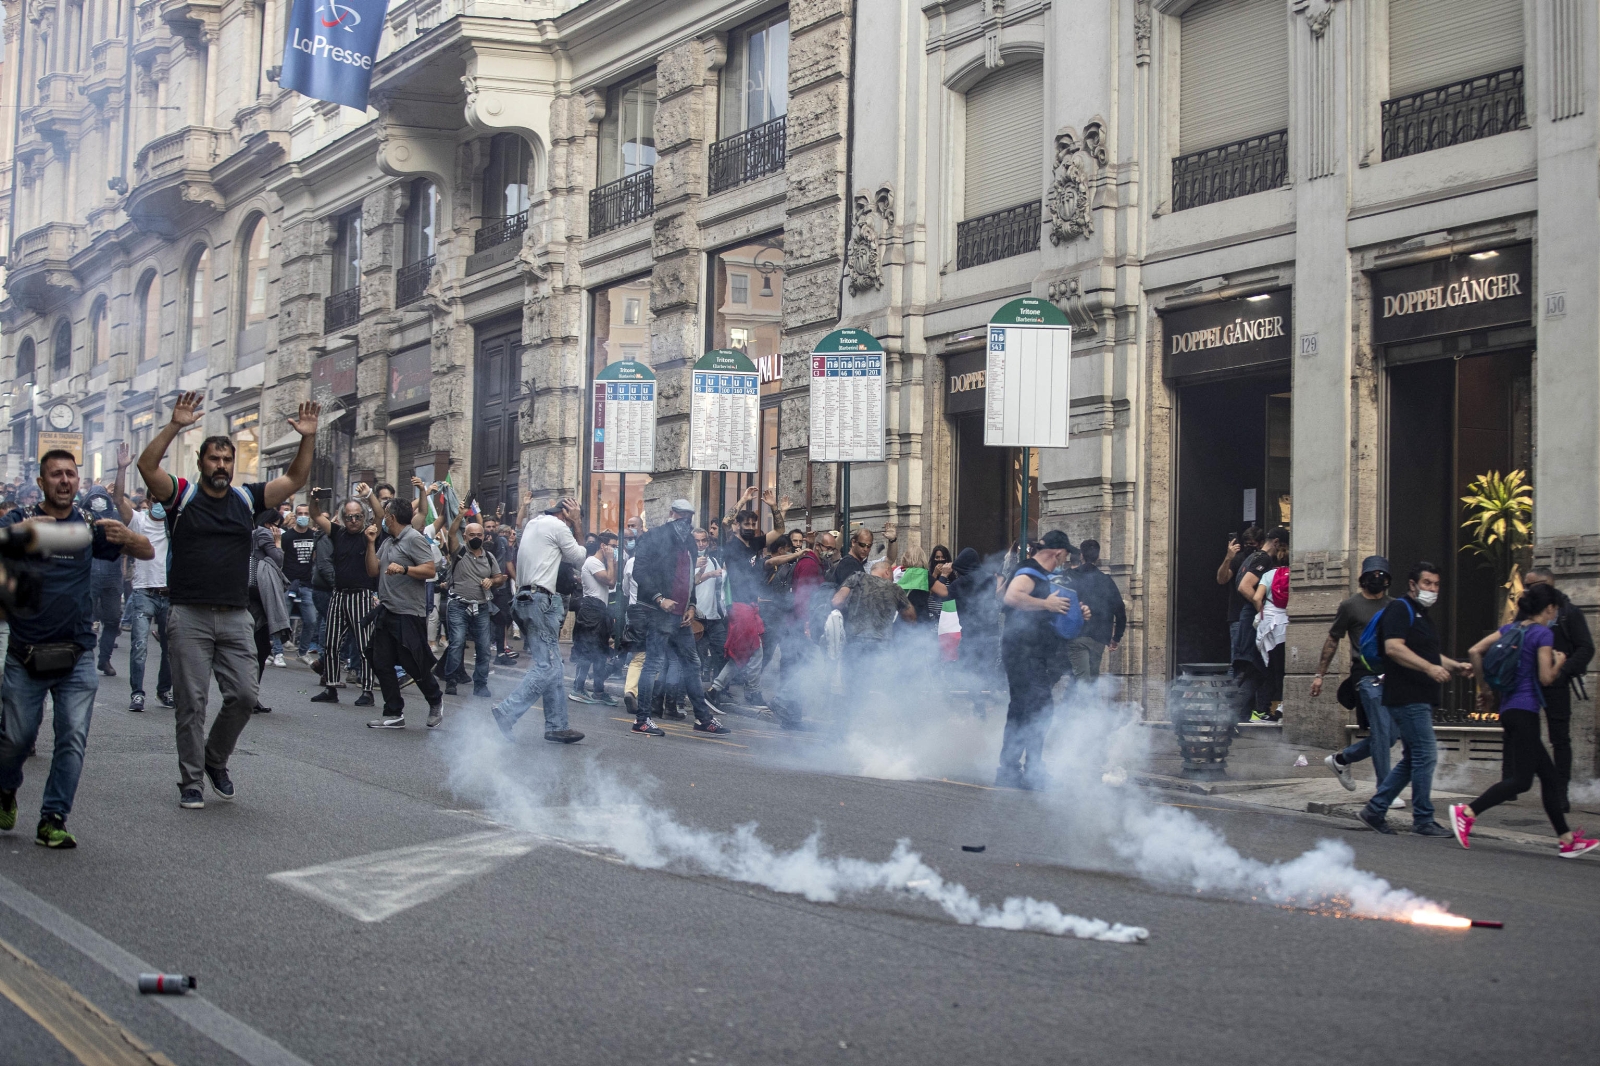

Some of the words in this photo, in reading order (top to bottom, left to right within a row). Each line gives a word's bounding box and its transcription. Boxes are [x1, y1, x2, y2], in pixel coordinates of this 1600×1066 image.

[292, 27, 372, 70] LaPresse
[1382, 272, 1522, 318] DOPPELGÄNGER
[1020, 307, 1041, 316] Tritone
[1546, 295, 1565, 314] 130
[1171, 315, 1285, 355] DOPPELGÄNGER
[991, 343, 1003, 351] 543
[1301, 336, 1317, 353] 129
[716, 356, 735, 364] Tritone
[813, 361, 819, 369] e
